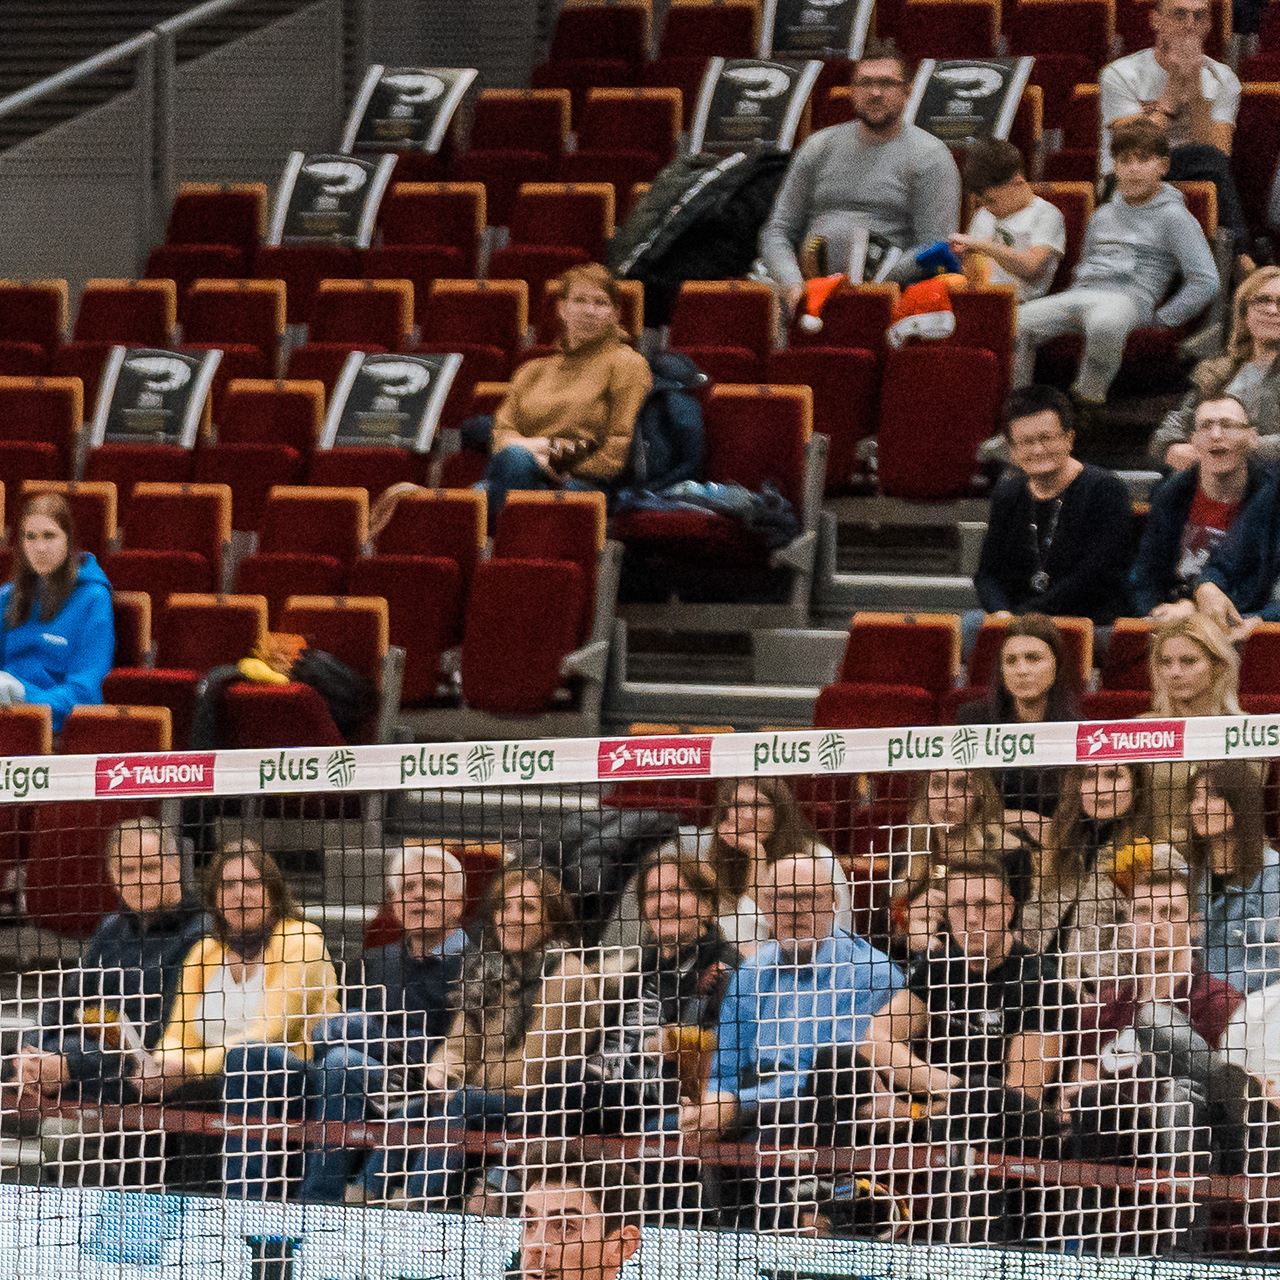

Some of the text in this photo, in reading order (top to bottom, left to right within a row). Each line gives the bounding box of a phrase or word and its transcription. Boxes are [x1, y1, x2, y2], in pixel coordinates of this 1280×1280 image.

[634, 747, 702, 767] TAURON
[753, 735, 810, 772] plus
[887, 727, 1036, 767] plus liga
[1111, 728, 1175, 750] TAURON
[134, 763, 205, 786] TAURON
[258, 751, 319, 790] plus
[399, 743, 554, 783] plus liga
